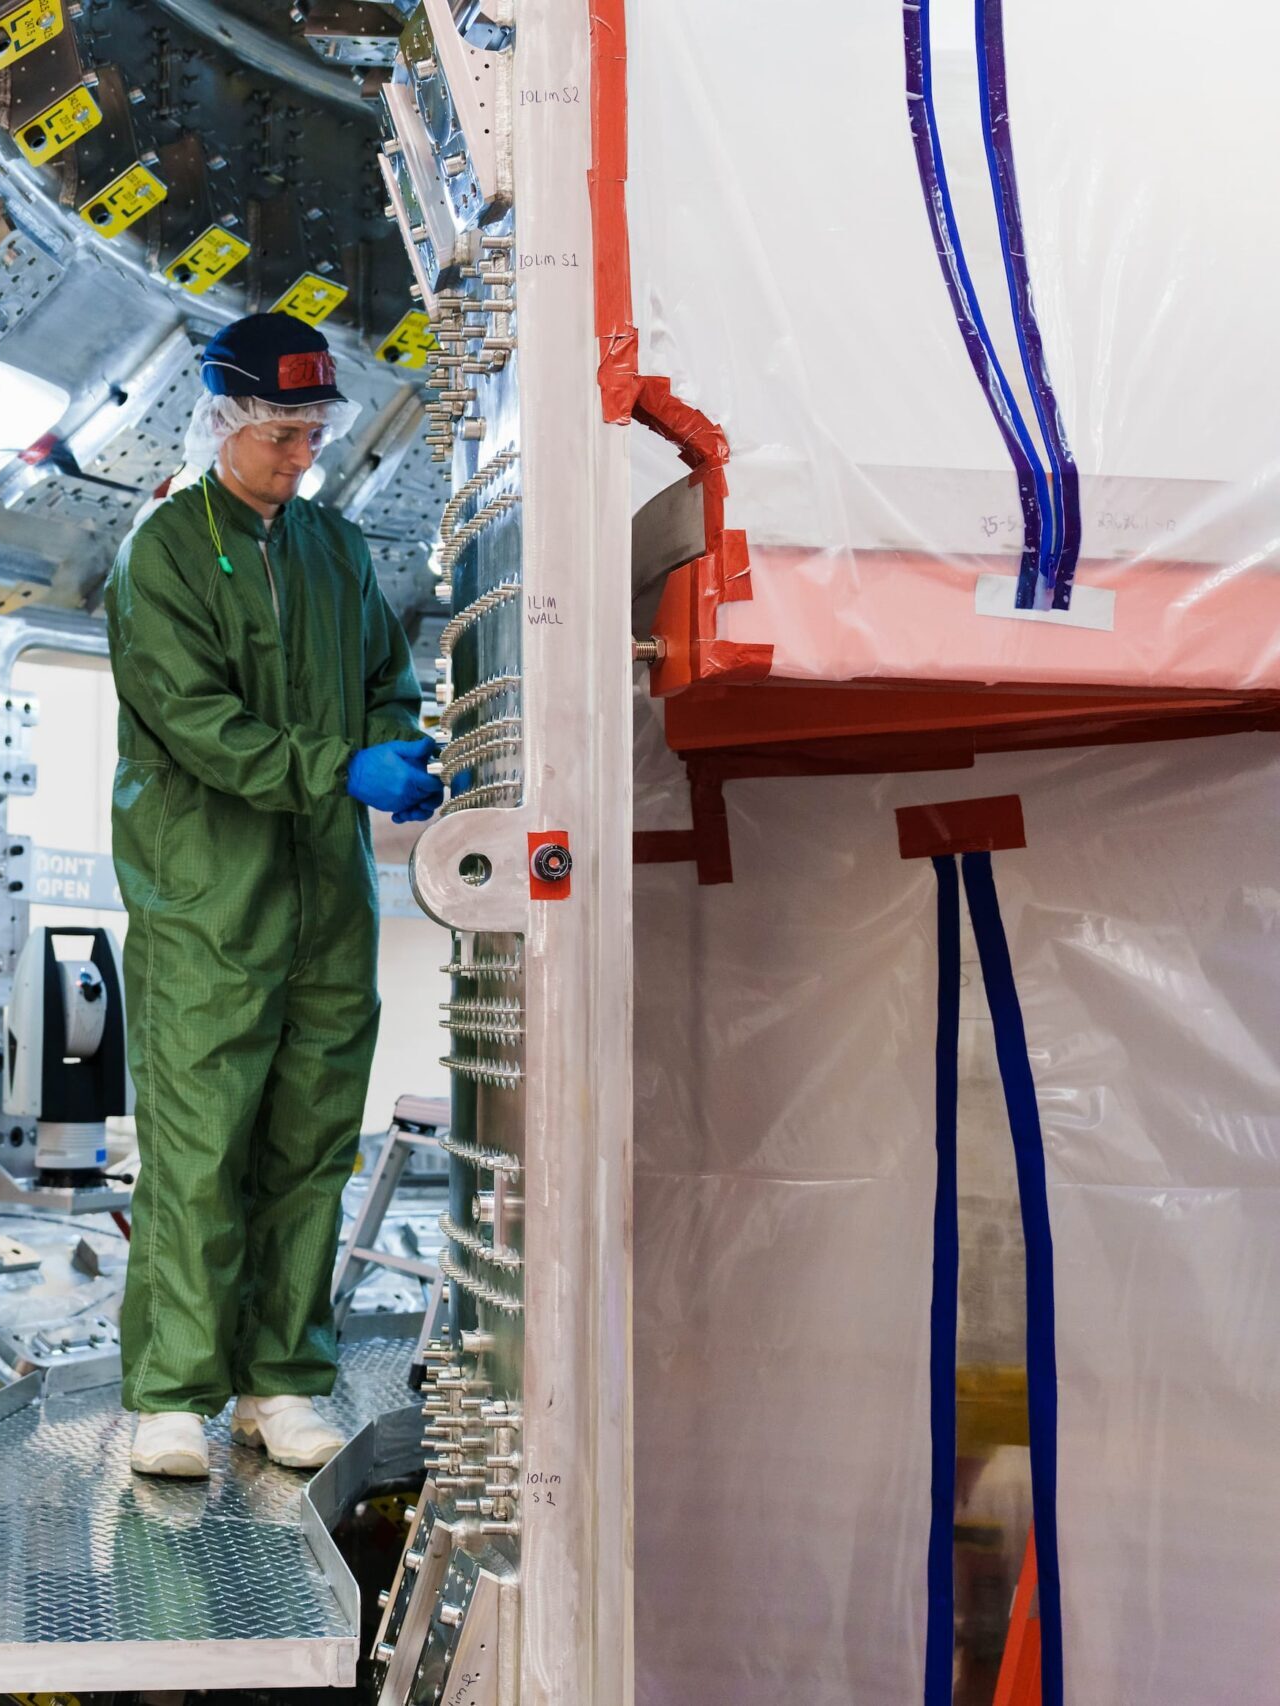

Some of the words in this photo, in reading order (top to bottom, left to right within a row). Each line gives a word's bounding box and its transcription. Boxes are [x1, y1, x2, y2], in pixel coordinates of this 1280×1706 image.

[528, 612, 564, 625] WALL
[37, 853, 97, 877] DON'T
[36, 877, 91, 900] OPEN
